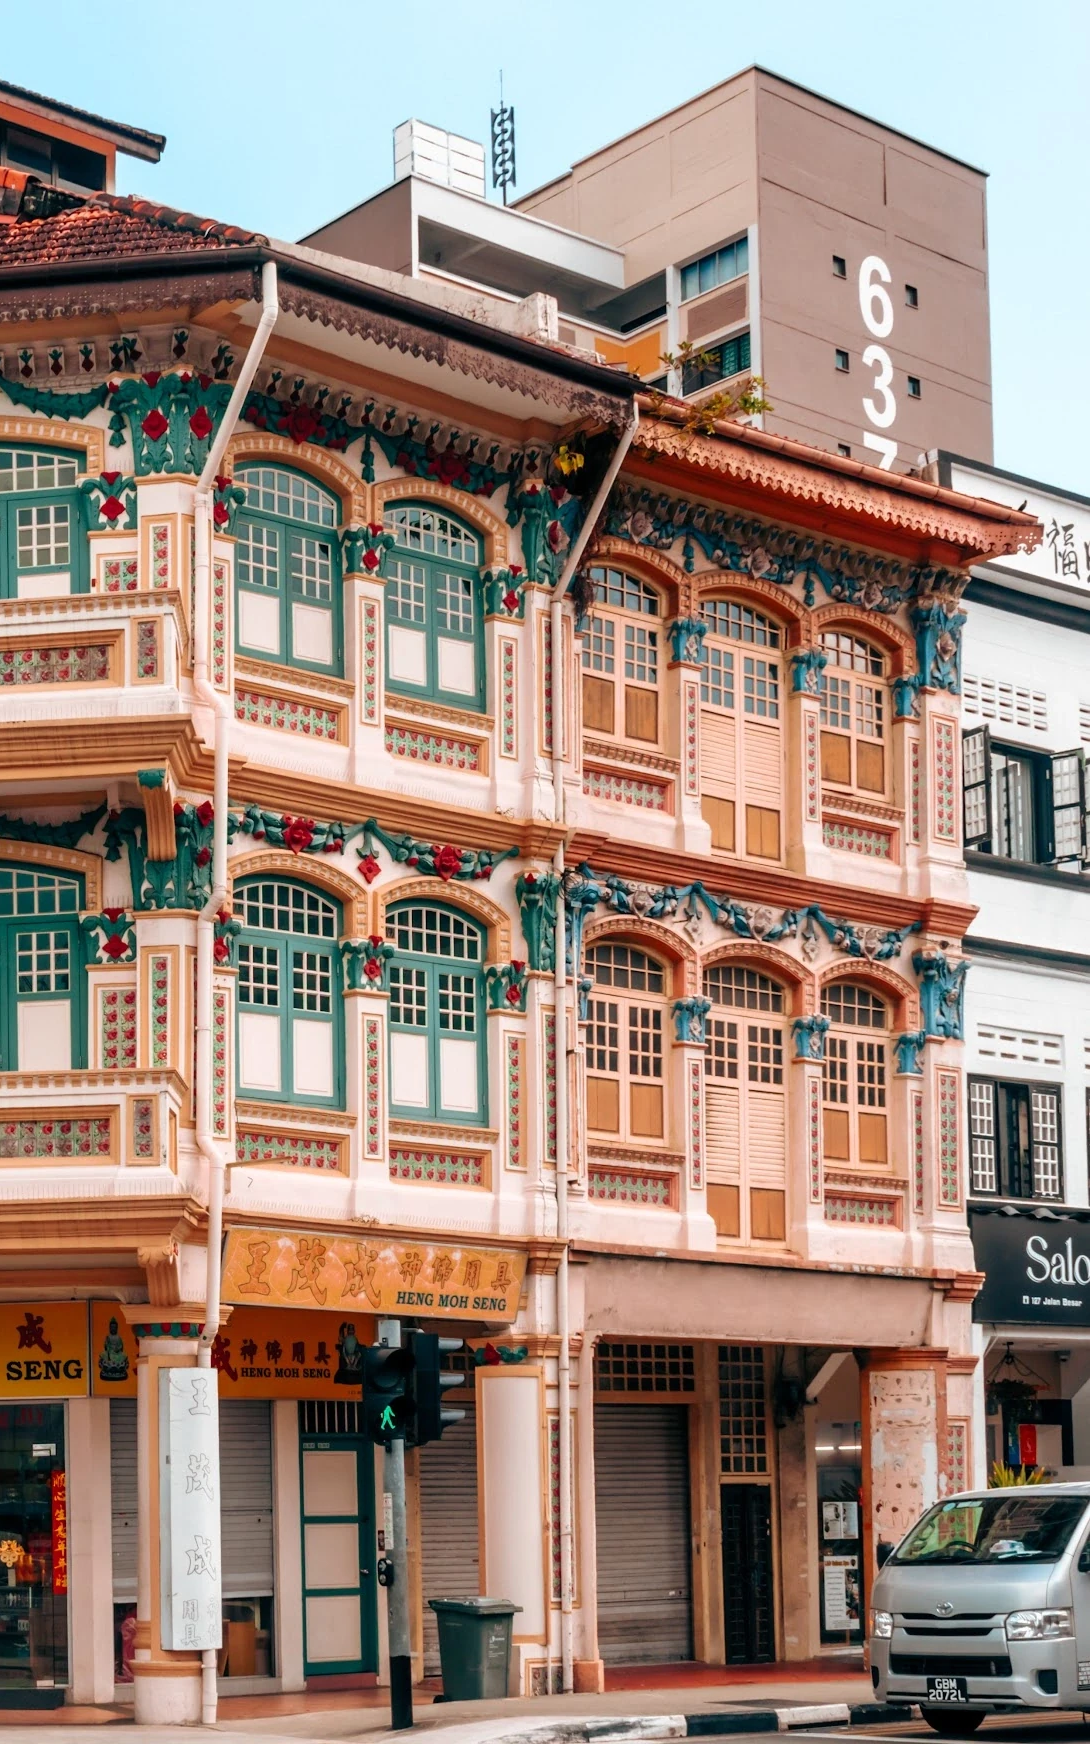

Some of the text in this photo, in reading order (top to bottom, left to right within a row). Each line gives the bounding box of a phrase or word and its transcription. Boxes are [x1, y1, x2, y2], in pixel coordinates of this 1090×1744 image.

[1026, 1235, 1090, 1286] Salo
[399, 1252, 512, 1294] 神佛用具
[396, 1291, 507, 1312] HENG MOH SENG
[1043, 1297, 1061, 1306] Jalan
[1062, 1297, 1082, 1307] Besar
[6, 1358, 84, 1382] SENG
[241, 1367, 331, 1379] HENG MOH SENG
[935, 1678, 957, 1690] GBM
[928, 1689, 966, 1701] 2072L
